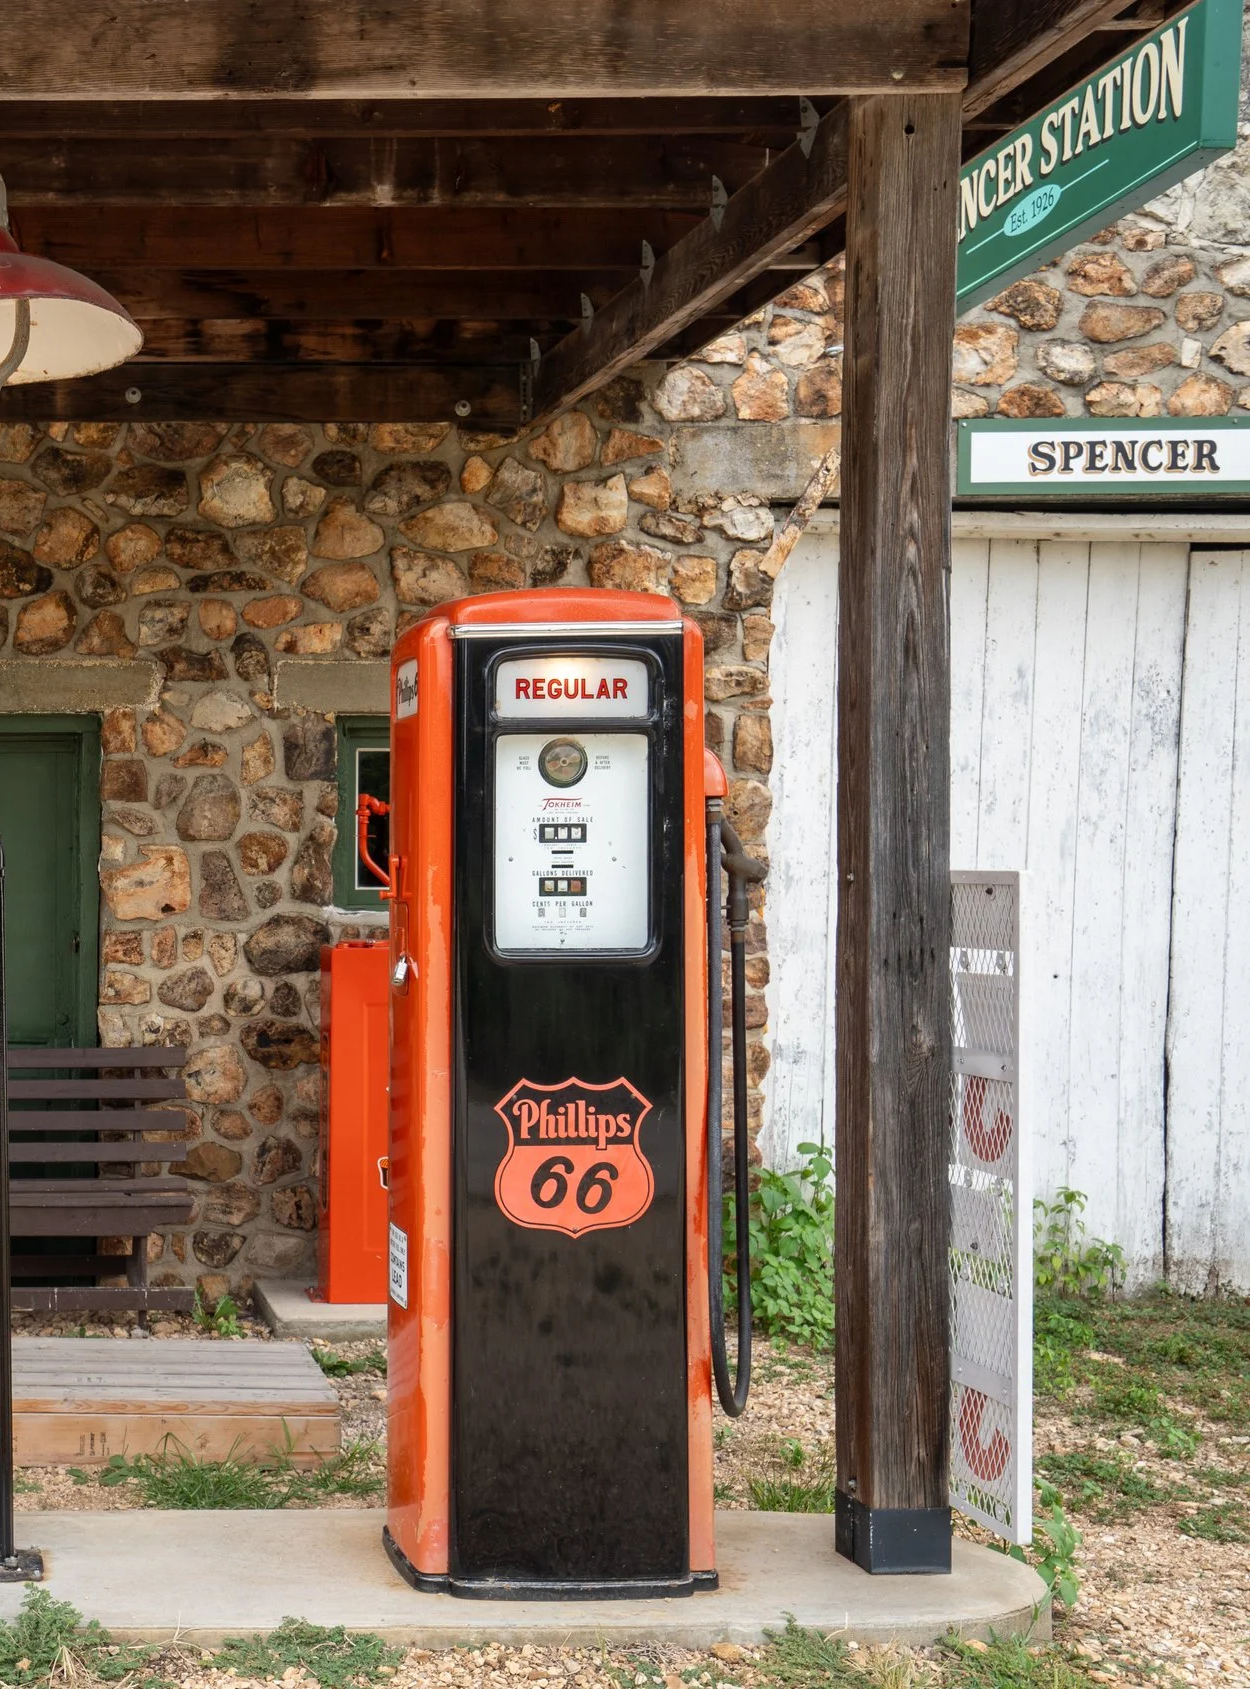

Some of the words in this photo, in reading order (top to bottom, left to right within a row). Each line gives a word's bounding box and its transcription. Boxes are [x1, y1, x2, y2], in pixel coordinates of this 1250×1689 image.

[958, 133, 1034, 242] NCER
[1039, 16, 1189, 176] STATION
[1010, 208, 1028, 234] Est.
[1031, 186, 1055, 219] 1926
[1027, 439, 1220, 476] SPENCER
[515, 678, 628, 700] REGULAR
[541, 797, 583, 811] TOKHEIM
[512, 1098, 632, 1151] Phillips
[530, 1155, 619, 1215] 66
[392, 1267, 403, 1288] LEAD
